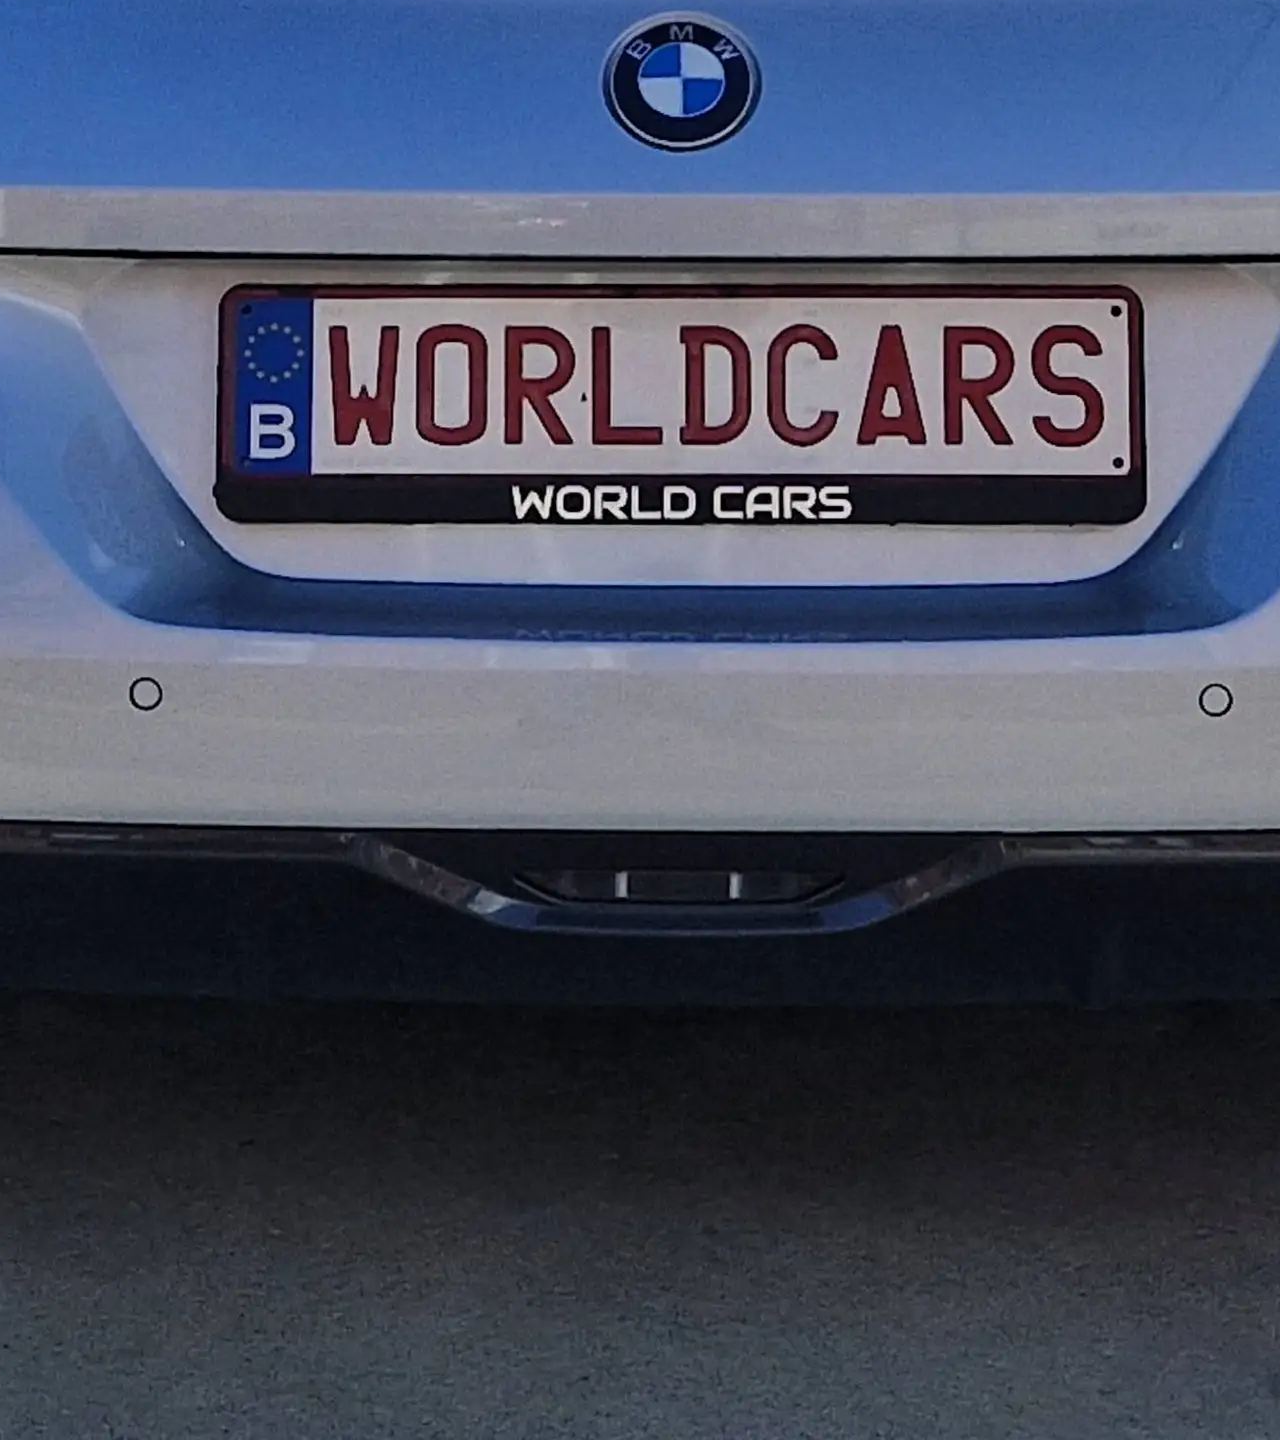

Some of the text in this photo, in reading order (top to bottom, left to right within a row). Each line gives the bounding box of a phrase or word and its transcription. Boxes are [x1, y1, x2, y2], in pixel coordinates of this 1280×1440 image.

[626, 24, 741, 60] BMW
[329, 323, 1105, 448] WORLDCARS
[249, 403, 296, 459] B
[512, 485, 853, 520] WORLD CARS
